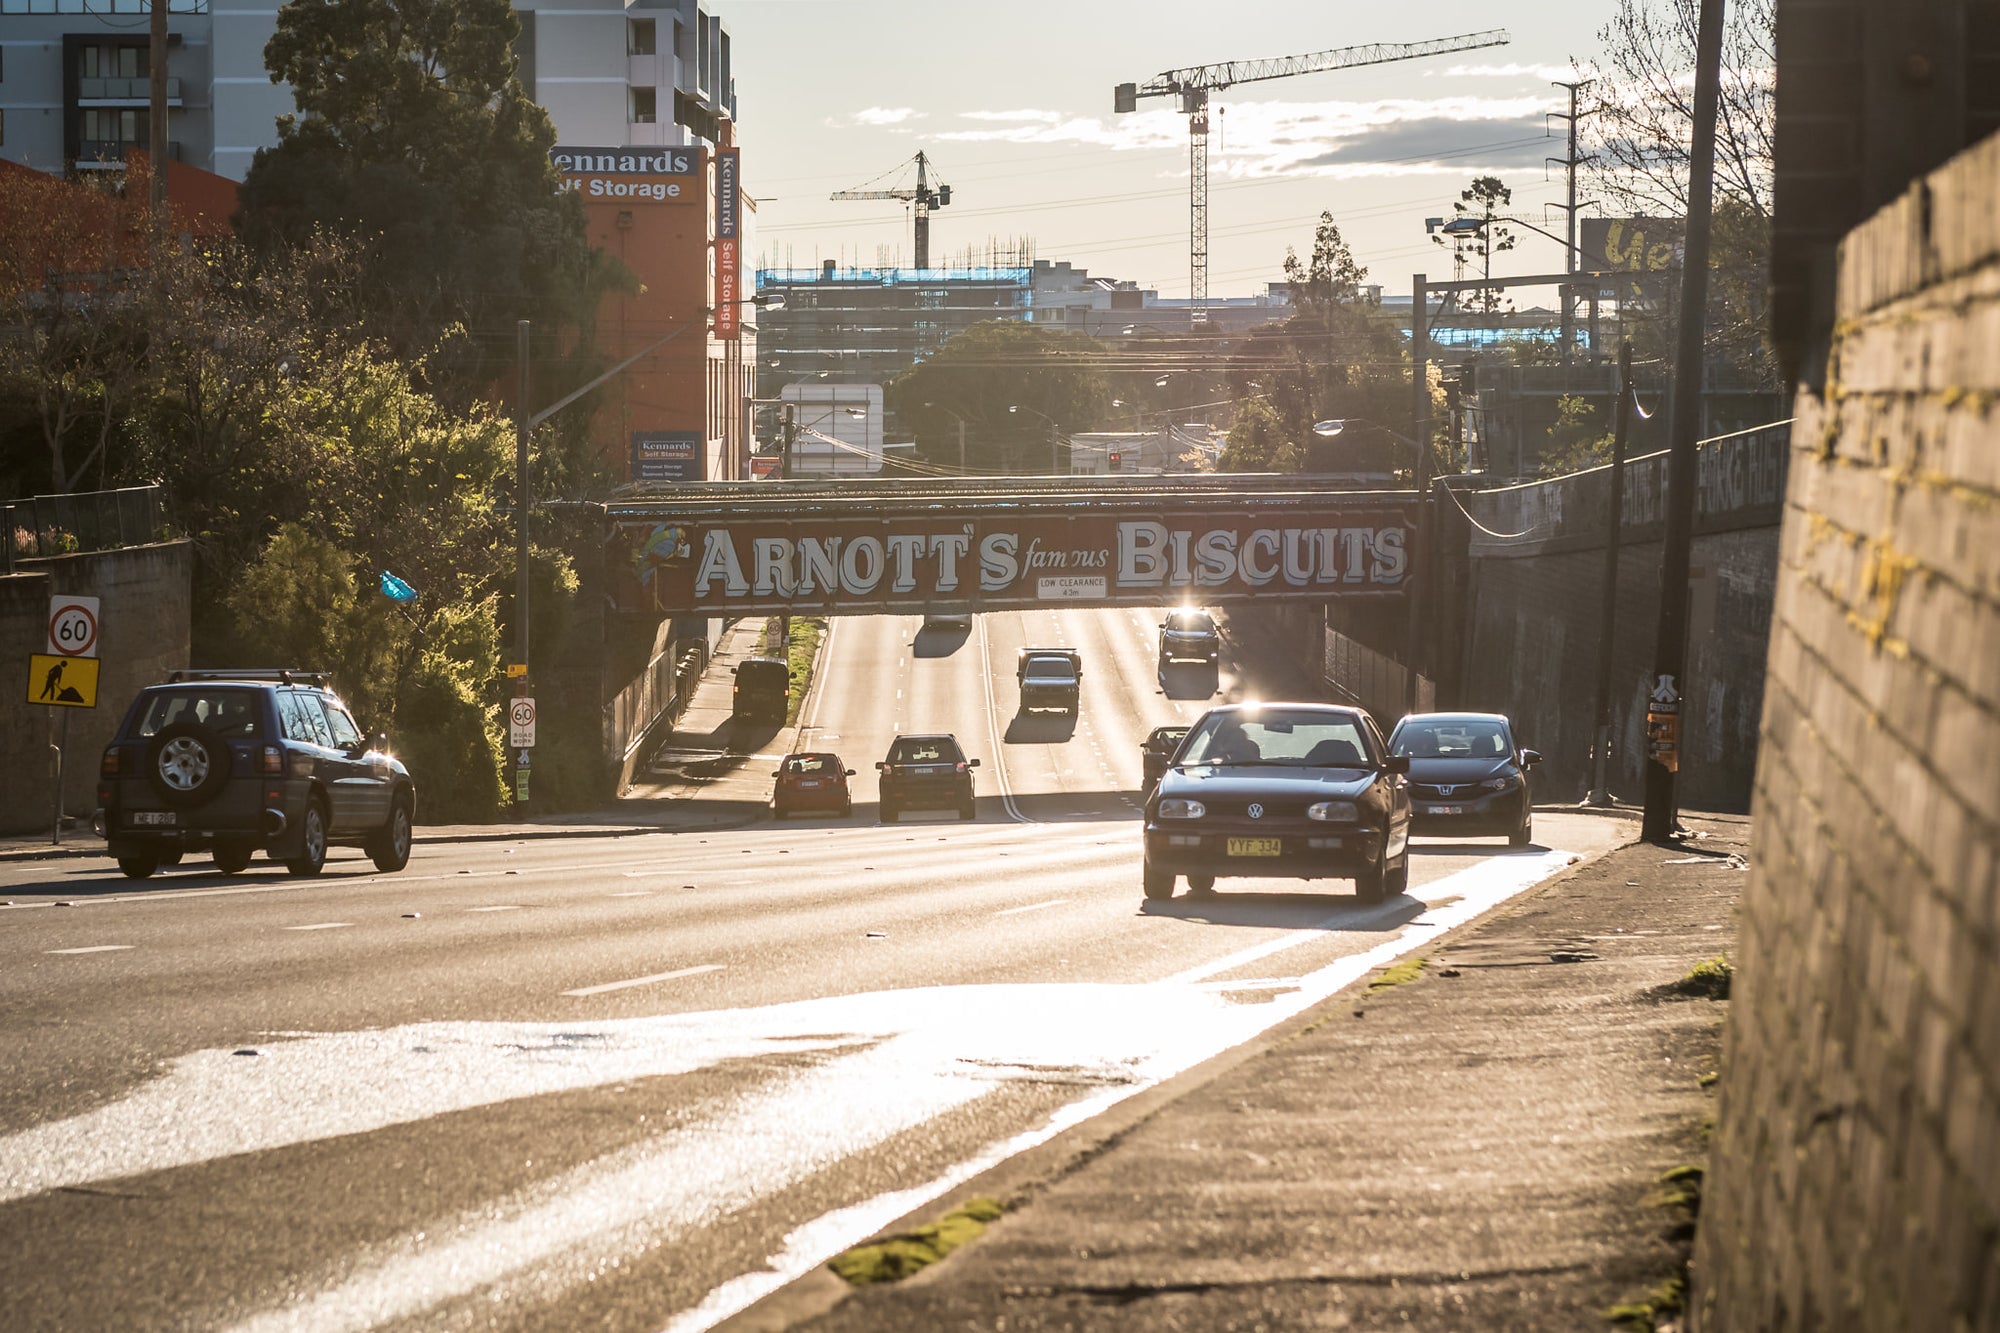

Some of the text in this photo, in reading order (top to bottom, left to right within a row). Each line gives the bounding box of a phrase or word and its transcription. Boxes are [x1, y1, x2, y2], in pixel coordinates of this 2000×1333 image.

[554, 151, 689, 173] ennards
[589, 179, 680, 200] Storage
[722, 157, 734, 330] Kennards Self Storage
[642, 442, 691, 450] Kennards
[695, 523, 1018, 598] ARNOTT'S
[1115, 521, 1408, 588] BISCUITS
[1040, 578, 1104, 587] LOW CLEARANCE
[60, 619, 87, 641] 60
[514, 708, 532, 721] 60
[1229, 839, 1279, 852] YYF 334
